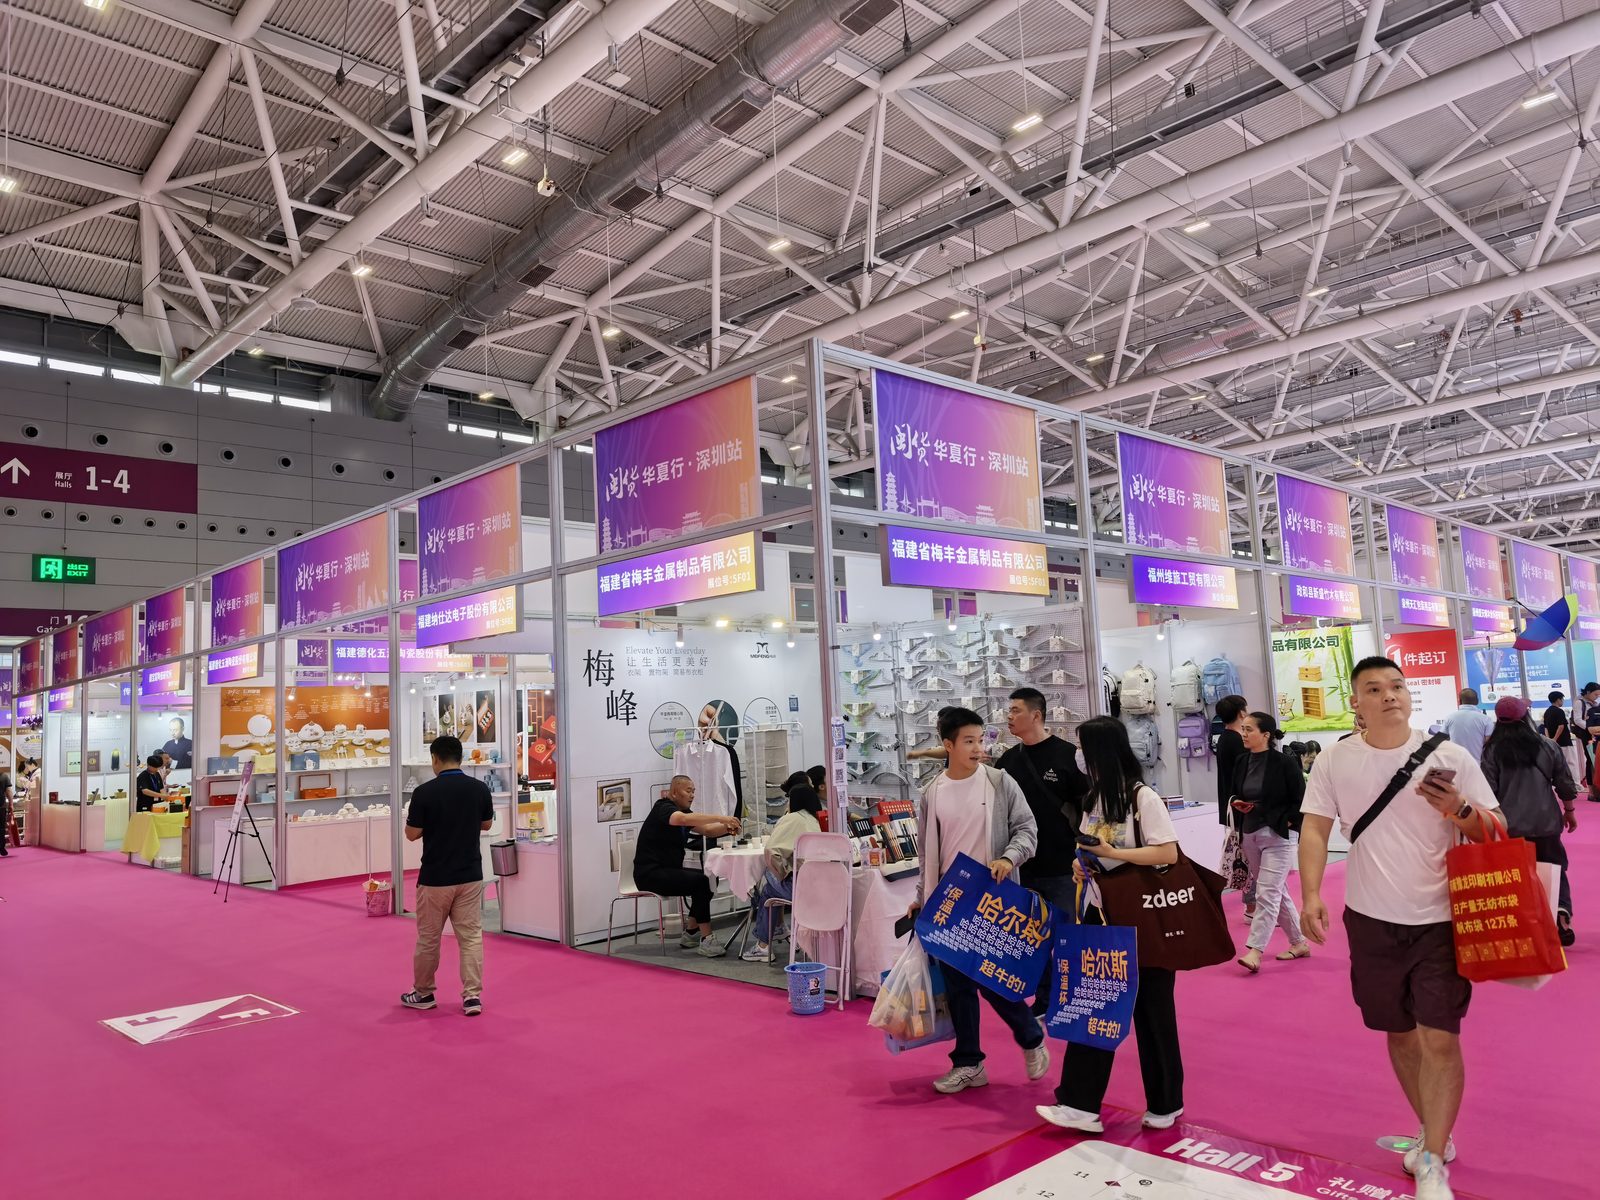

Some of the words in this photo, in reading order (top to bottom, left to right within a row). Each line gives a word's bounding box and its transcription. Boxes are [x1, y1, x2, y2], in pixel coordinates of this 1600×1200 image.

[54, 480, 72, 489] Halls
[55, 471, 72, 481] 展厅
[85, 466, 131, 494] 1-4
[892, 538, 1045, 571] 福建省梅丰金属制品有限公司
[67, 563, 89, 571] 出口
[600, 545, 750, 593] 福建省梅丰金属制品有限公司
[626, 646, 653, 655] Elevate
[655, 646, 672, 655] Your
[674, 646, 706, 657] Everyday
[1272, 635, 1340, 652] 品有限公司
[933, 886, 964, 927] 保温杯
[1142, 886, 1195, 909] zdeer
[1081, 947, 1128, 981] 哈尔斯
[979, 959, 1026, 994] 超牛的!
[1088, 1016, 1121, 1039] 超牛的!
[1162, 1137, 1264, 1173] Hall
[1259, 1161, 1304, 1183] 5
[1073, 1171, 1090, 1179] 11
[1036, 1189, 1055, 1199] 12
